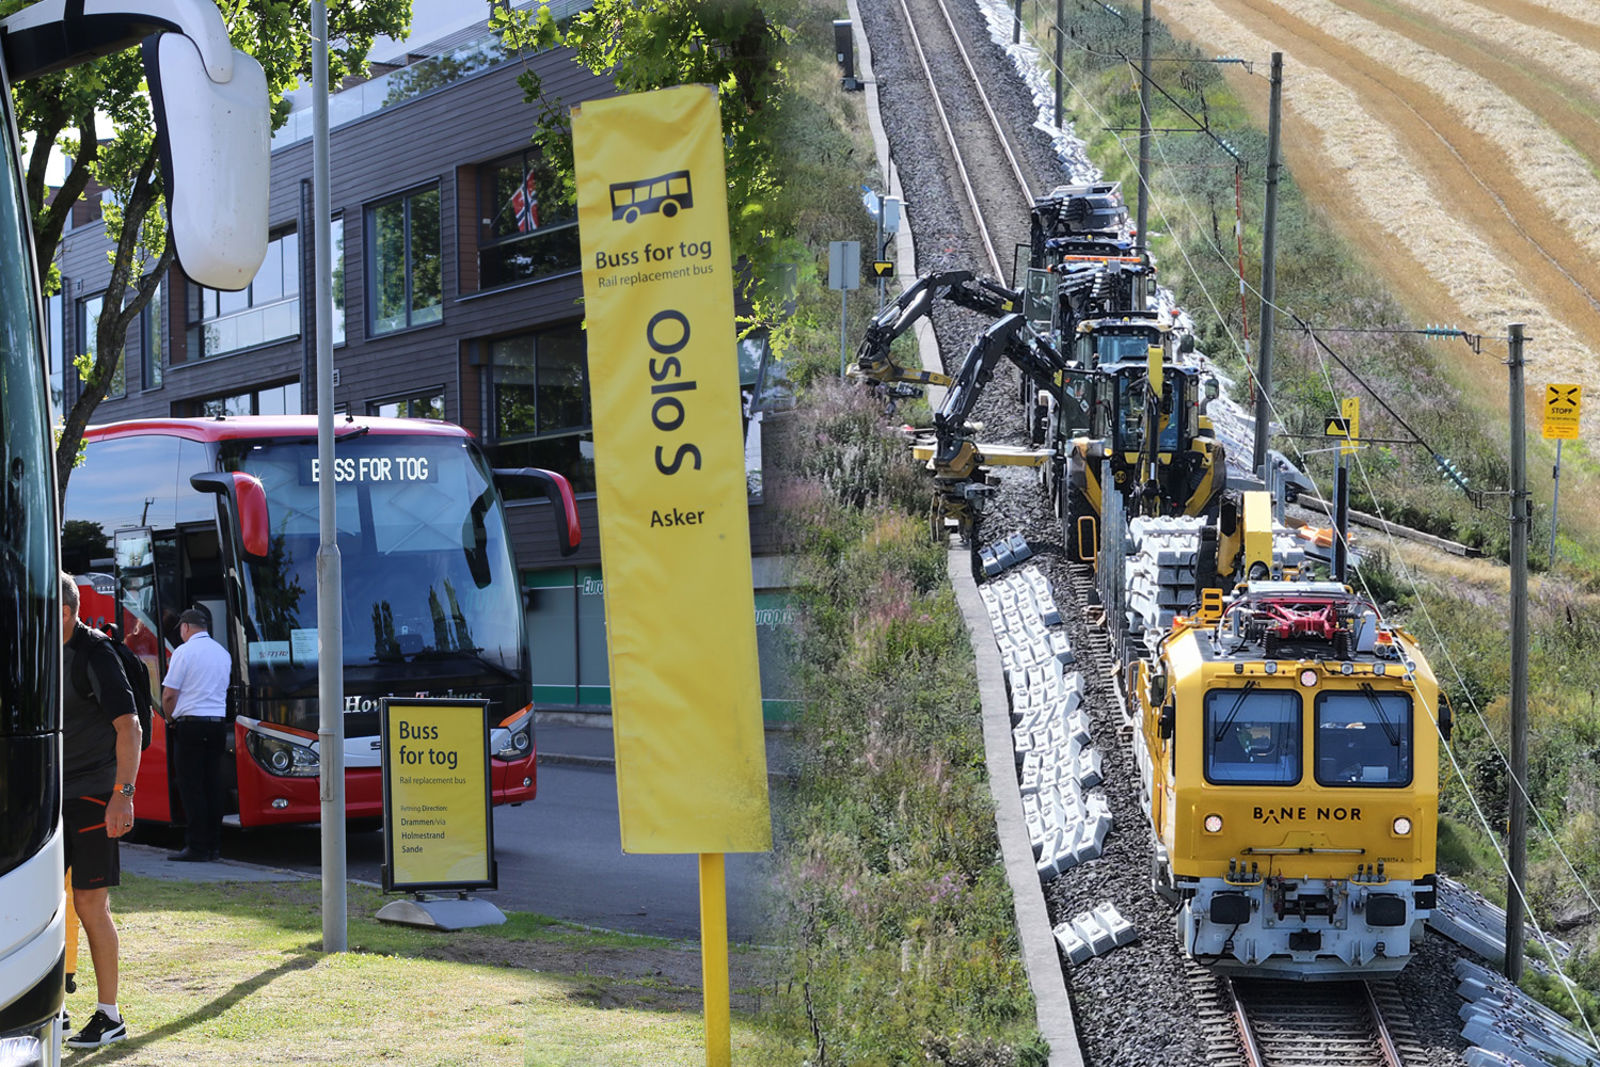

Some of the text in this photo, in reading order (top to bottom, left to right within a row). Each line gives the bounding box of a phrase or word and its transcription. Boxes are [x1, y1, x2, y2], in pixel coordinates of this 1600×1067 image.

[595, 240, 712, 270] Buss for tog
[598, 263, 714, 289] Rail replacement bus
[646, 309, 702, 476] Oslo S
[311, 457, 429, 482] BSS FOR TOG
[649, 507, 705, 528] Asker
[583, 576, 604, 596] Euro
[754, 604, 797, 631] uropris
[399, 720, 439, 740] Buss
[399, 745, 425, 765] for
[428, 748, 458, 770] tog
[399, 776, 467, 786] Rail replacement bus
[1253, 806, 1362, 825] BANE NOR
[401, 830, 446, 840] Holmestrand
[401, 844, 424, 854] Sande
